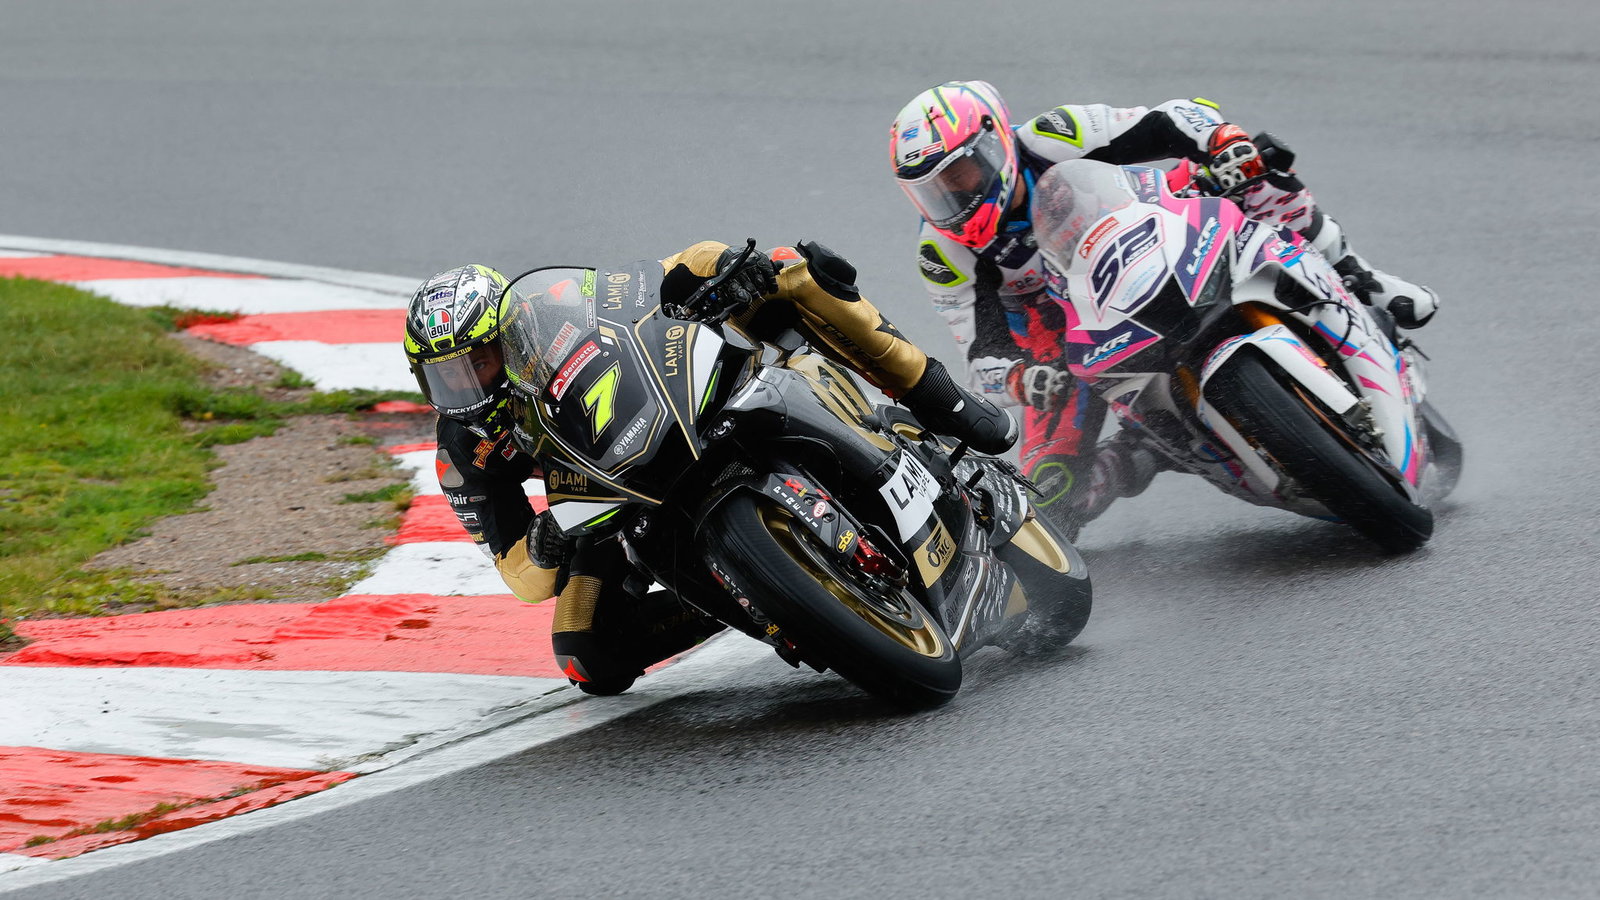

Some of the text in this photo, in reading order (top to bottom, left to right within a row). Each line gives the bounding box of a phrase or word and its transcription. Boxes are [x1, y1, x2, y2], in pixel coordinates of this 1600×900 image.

[1091, 217, 1157, 309] 52
[607, 285, 622, 310] LAMI
[431, 323, 450, 336] agv
[562, 345, 596, 379] Bennetts
[665, 341, 678, 377] LAMI
[1083, 331, 1133, 364] LKR
[446, 394, 495, 414] MICKYBONZ
[582, 363, 620, 438] 7
[619, 417, 647, 447] YAMAHA
[560, 472, 588, 487] LAMI
[890, 455, 924, 510] LAMI
[773, 486, 819, 528] PIRELLI
[839, 530, 854, 552] sbs
[927, 536, 950, 568] OMC
[766, 623, 780, 636] sbs
